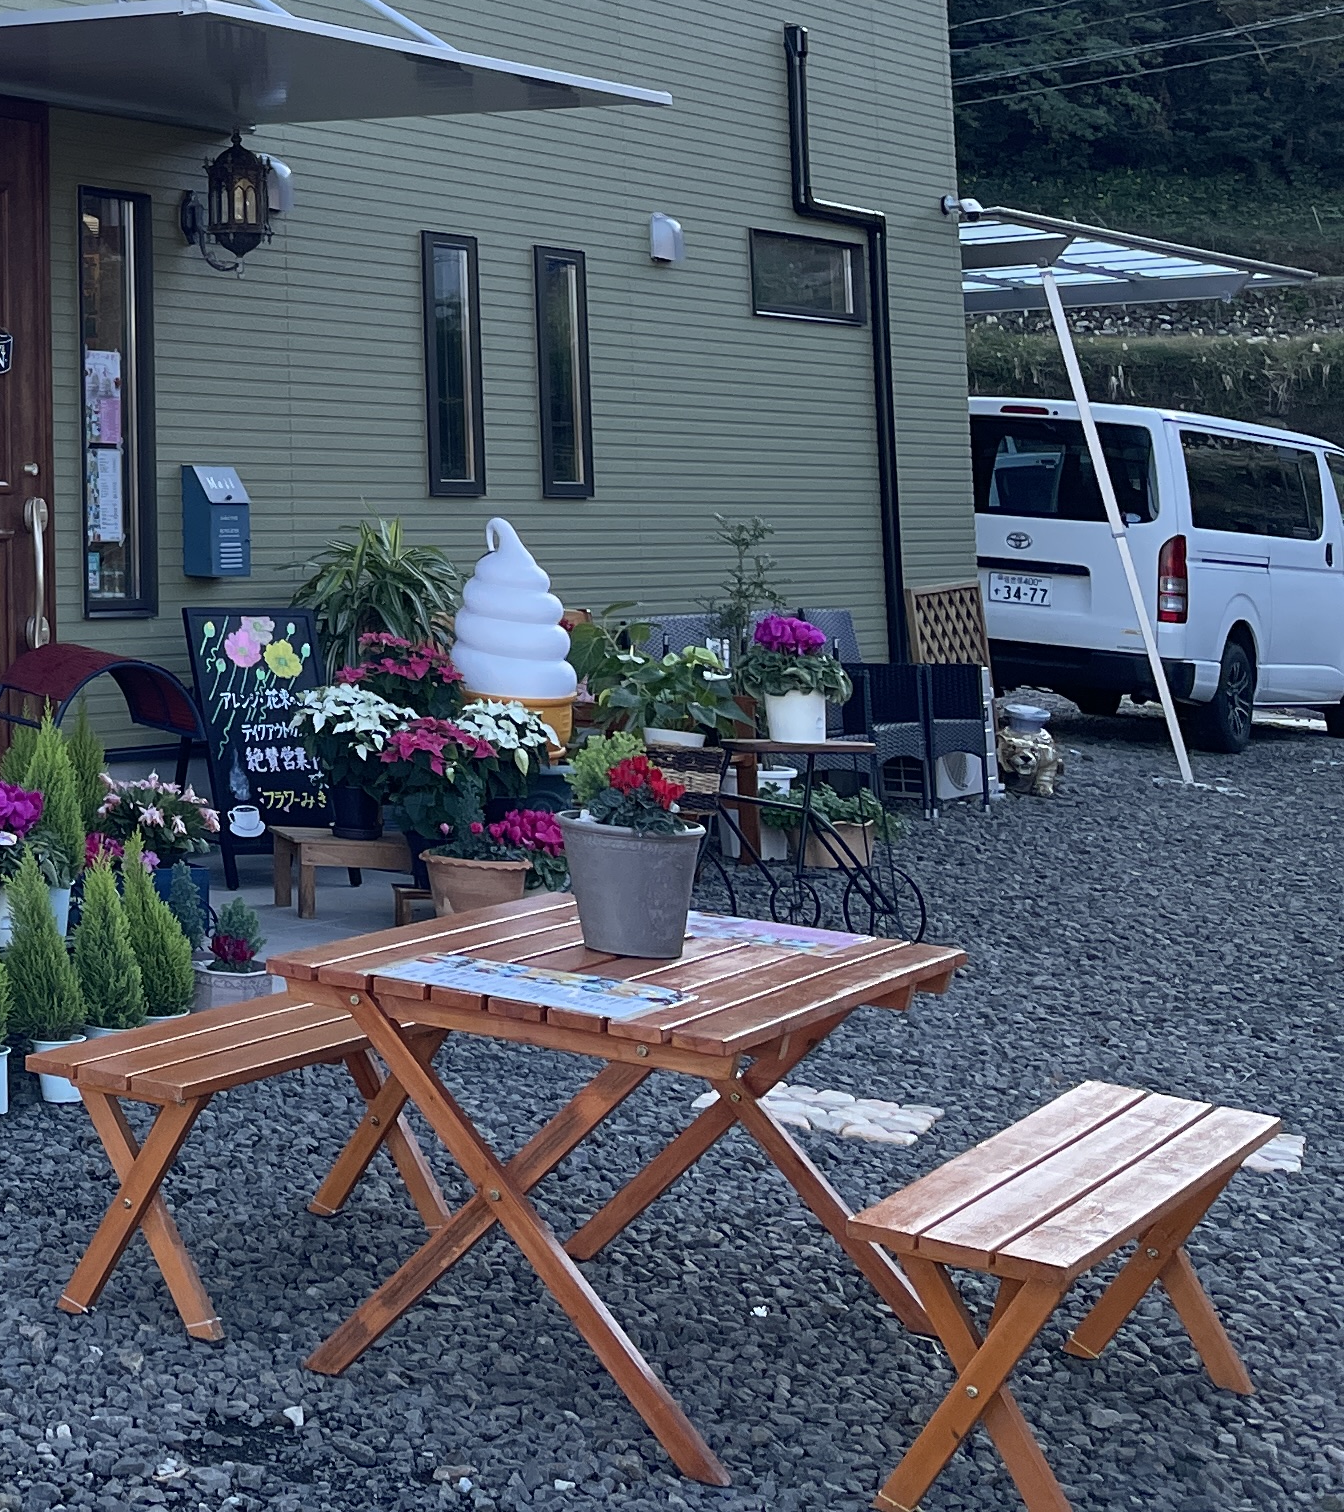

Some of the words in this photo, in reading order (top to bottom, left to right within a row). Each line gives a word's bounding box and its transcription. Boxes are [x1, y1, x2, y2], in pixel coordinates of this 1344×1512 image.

[205, 476, 235, 490] Mail
[1003, 585, 1048, 603] 34-77
[262, 790, 327, 809] フラワーみき
